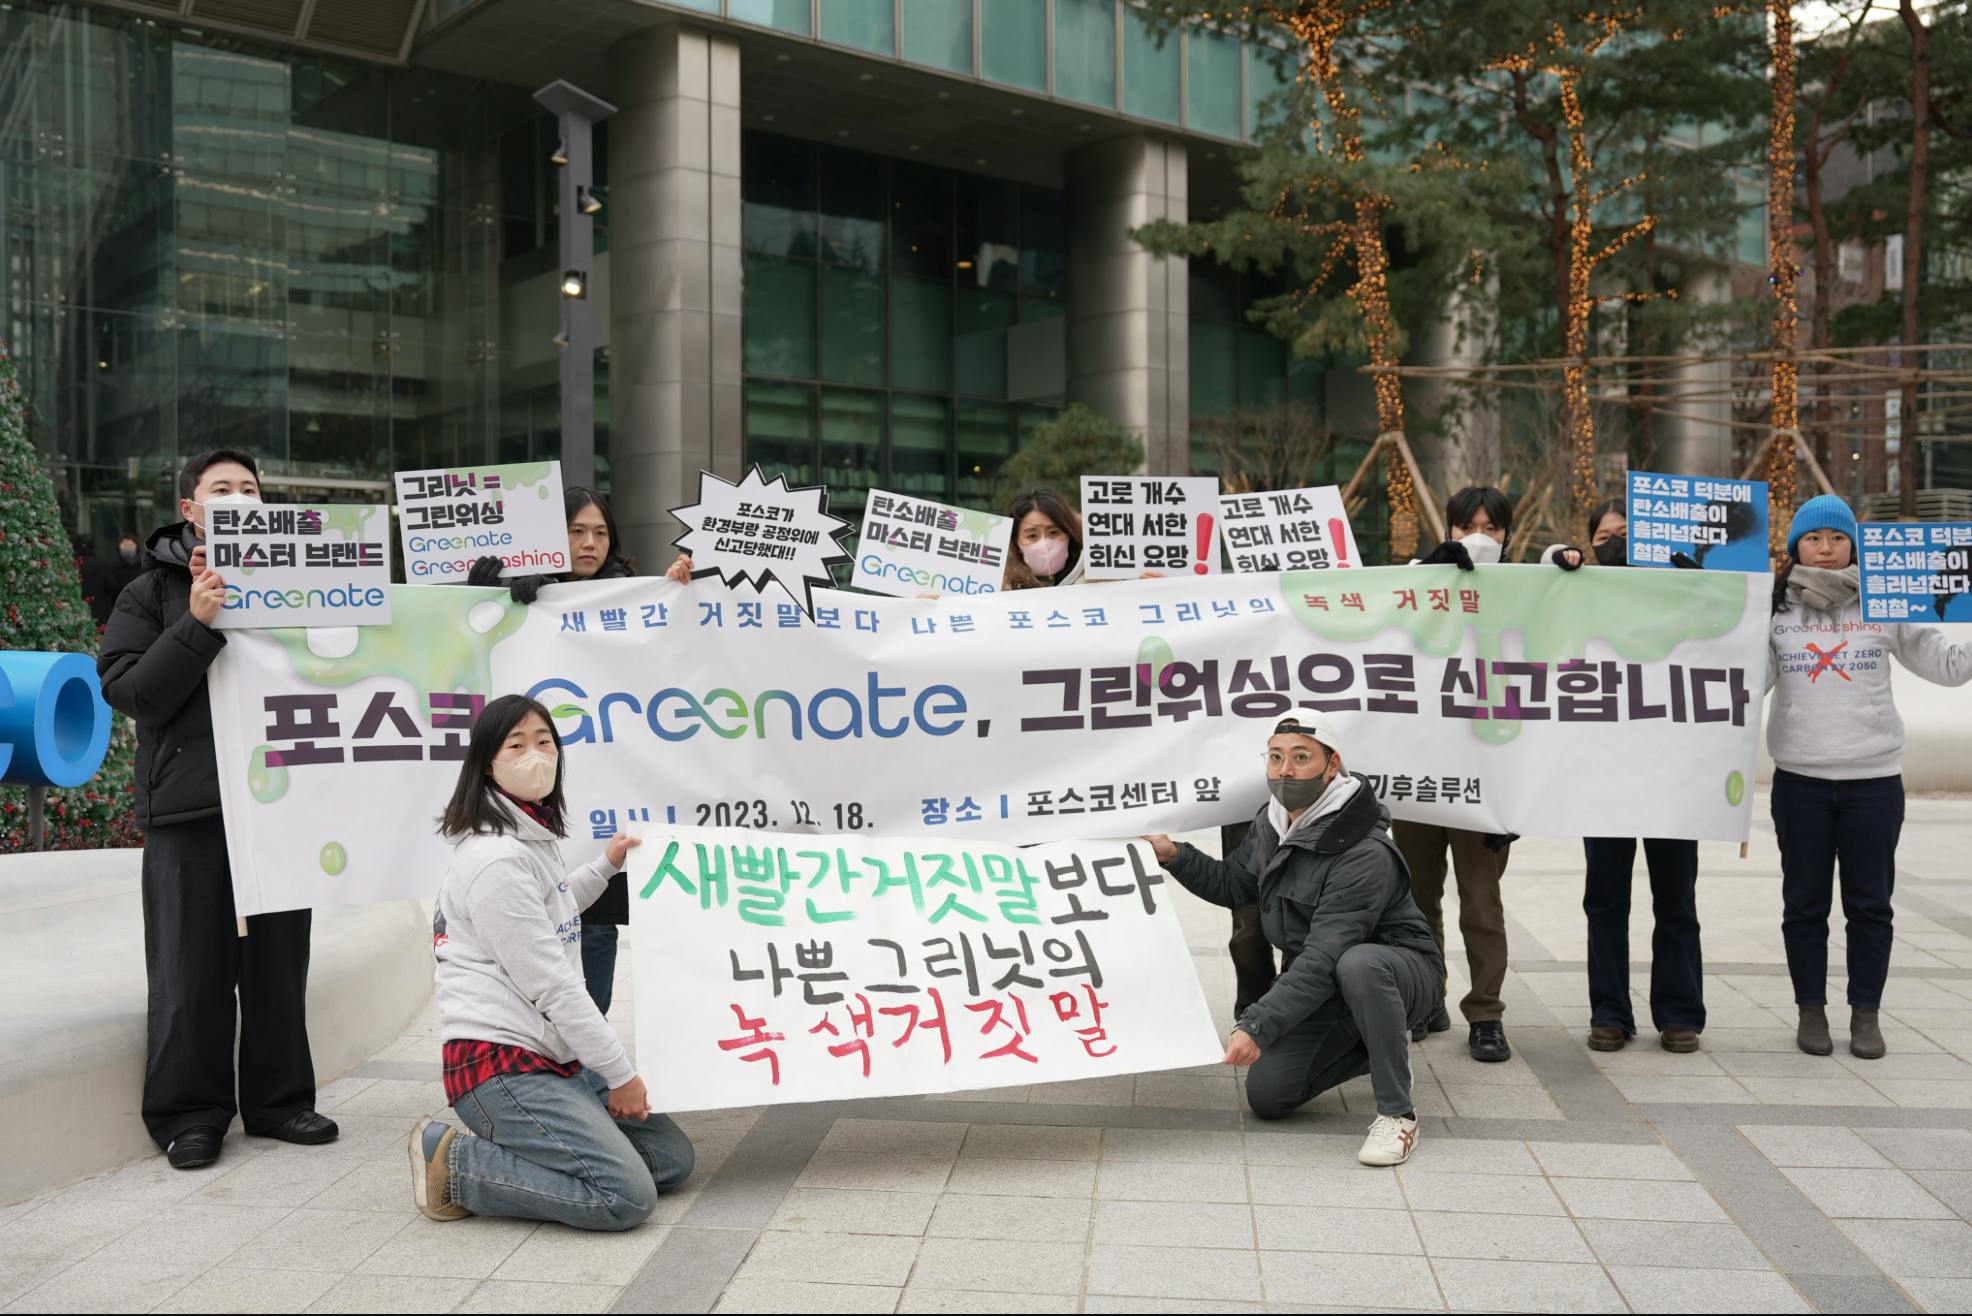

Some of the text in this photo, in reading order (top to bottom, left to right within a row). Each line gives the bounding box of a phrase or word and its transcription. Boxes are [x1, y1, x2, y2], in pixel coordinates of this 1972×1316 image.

[403, 472, 477, 500] 그리닛
[1088, 481, 1186, 505] 고로 개수
[1633, 476, 1751, 503] 포스코 덕분에
[406, 500, 505, 530] 그린워싱
[736, 502, 794, 522] 포스코가
[871, 495, 958, 532] 탄소배출
[1220, 493, 1313, 520] 고로 개수
[1633, 498, 1727, 523] 탄소배출이
[213, 509, 322, 535] 탄소배출
[701, 516, 819, 545] 환경부랑 공정위에
[1088, 512, 1187, 537] 연대 서한
[1228, 520, 1322, 548] 연대 서한
[1633, 520, 1728, 545] 흘러넘친다
[409, 531, 512, 553] Greenate
[714, 537, 796, 560] 신고당했대!!
[866, 521, 1002, 567] 마스터 브랜드
[1864, 528, 1925, 546] 포스코
[214, 543, 384, 567] 마스터 브랜드
[411, 549, 565, 577] Greenashing
[1089, 544, 1135, 568] 회신
[1143, 545, 1188, 568] 요망
[1286, 548, 1330, 571] 요망
[1864, 550, 1968, 570] 탄소배출이
[861, 555, 995, 595] Greenate
[1866, 574, 1970, 594] 흘러넘친다
[222, 583, 385, 610] Greenate
[1849, 661, 1877, 671] 2050
[1854, 648, 1882, 659] ZERO
[264, 692, 486, 768] 포스코
[1021, 653, 1420, 733] 그린워싱으로
[1440, 658, 1750, 727] 신고합니다
[921, 796, 982, 826] 장소
[1027, 780, 1179, 817] 포스코센터
[1194, 776, 1222, 802] 앞
[1367, 774, 1482, 804] 기후솔루션
[833, 802, 874, 830] 18.
